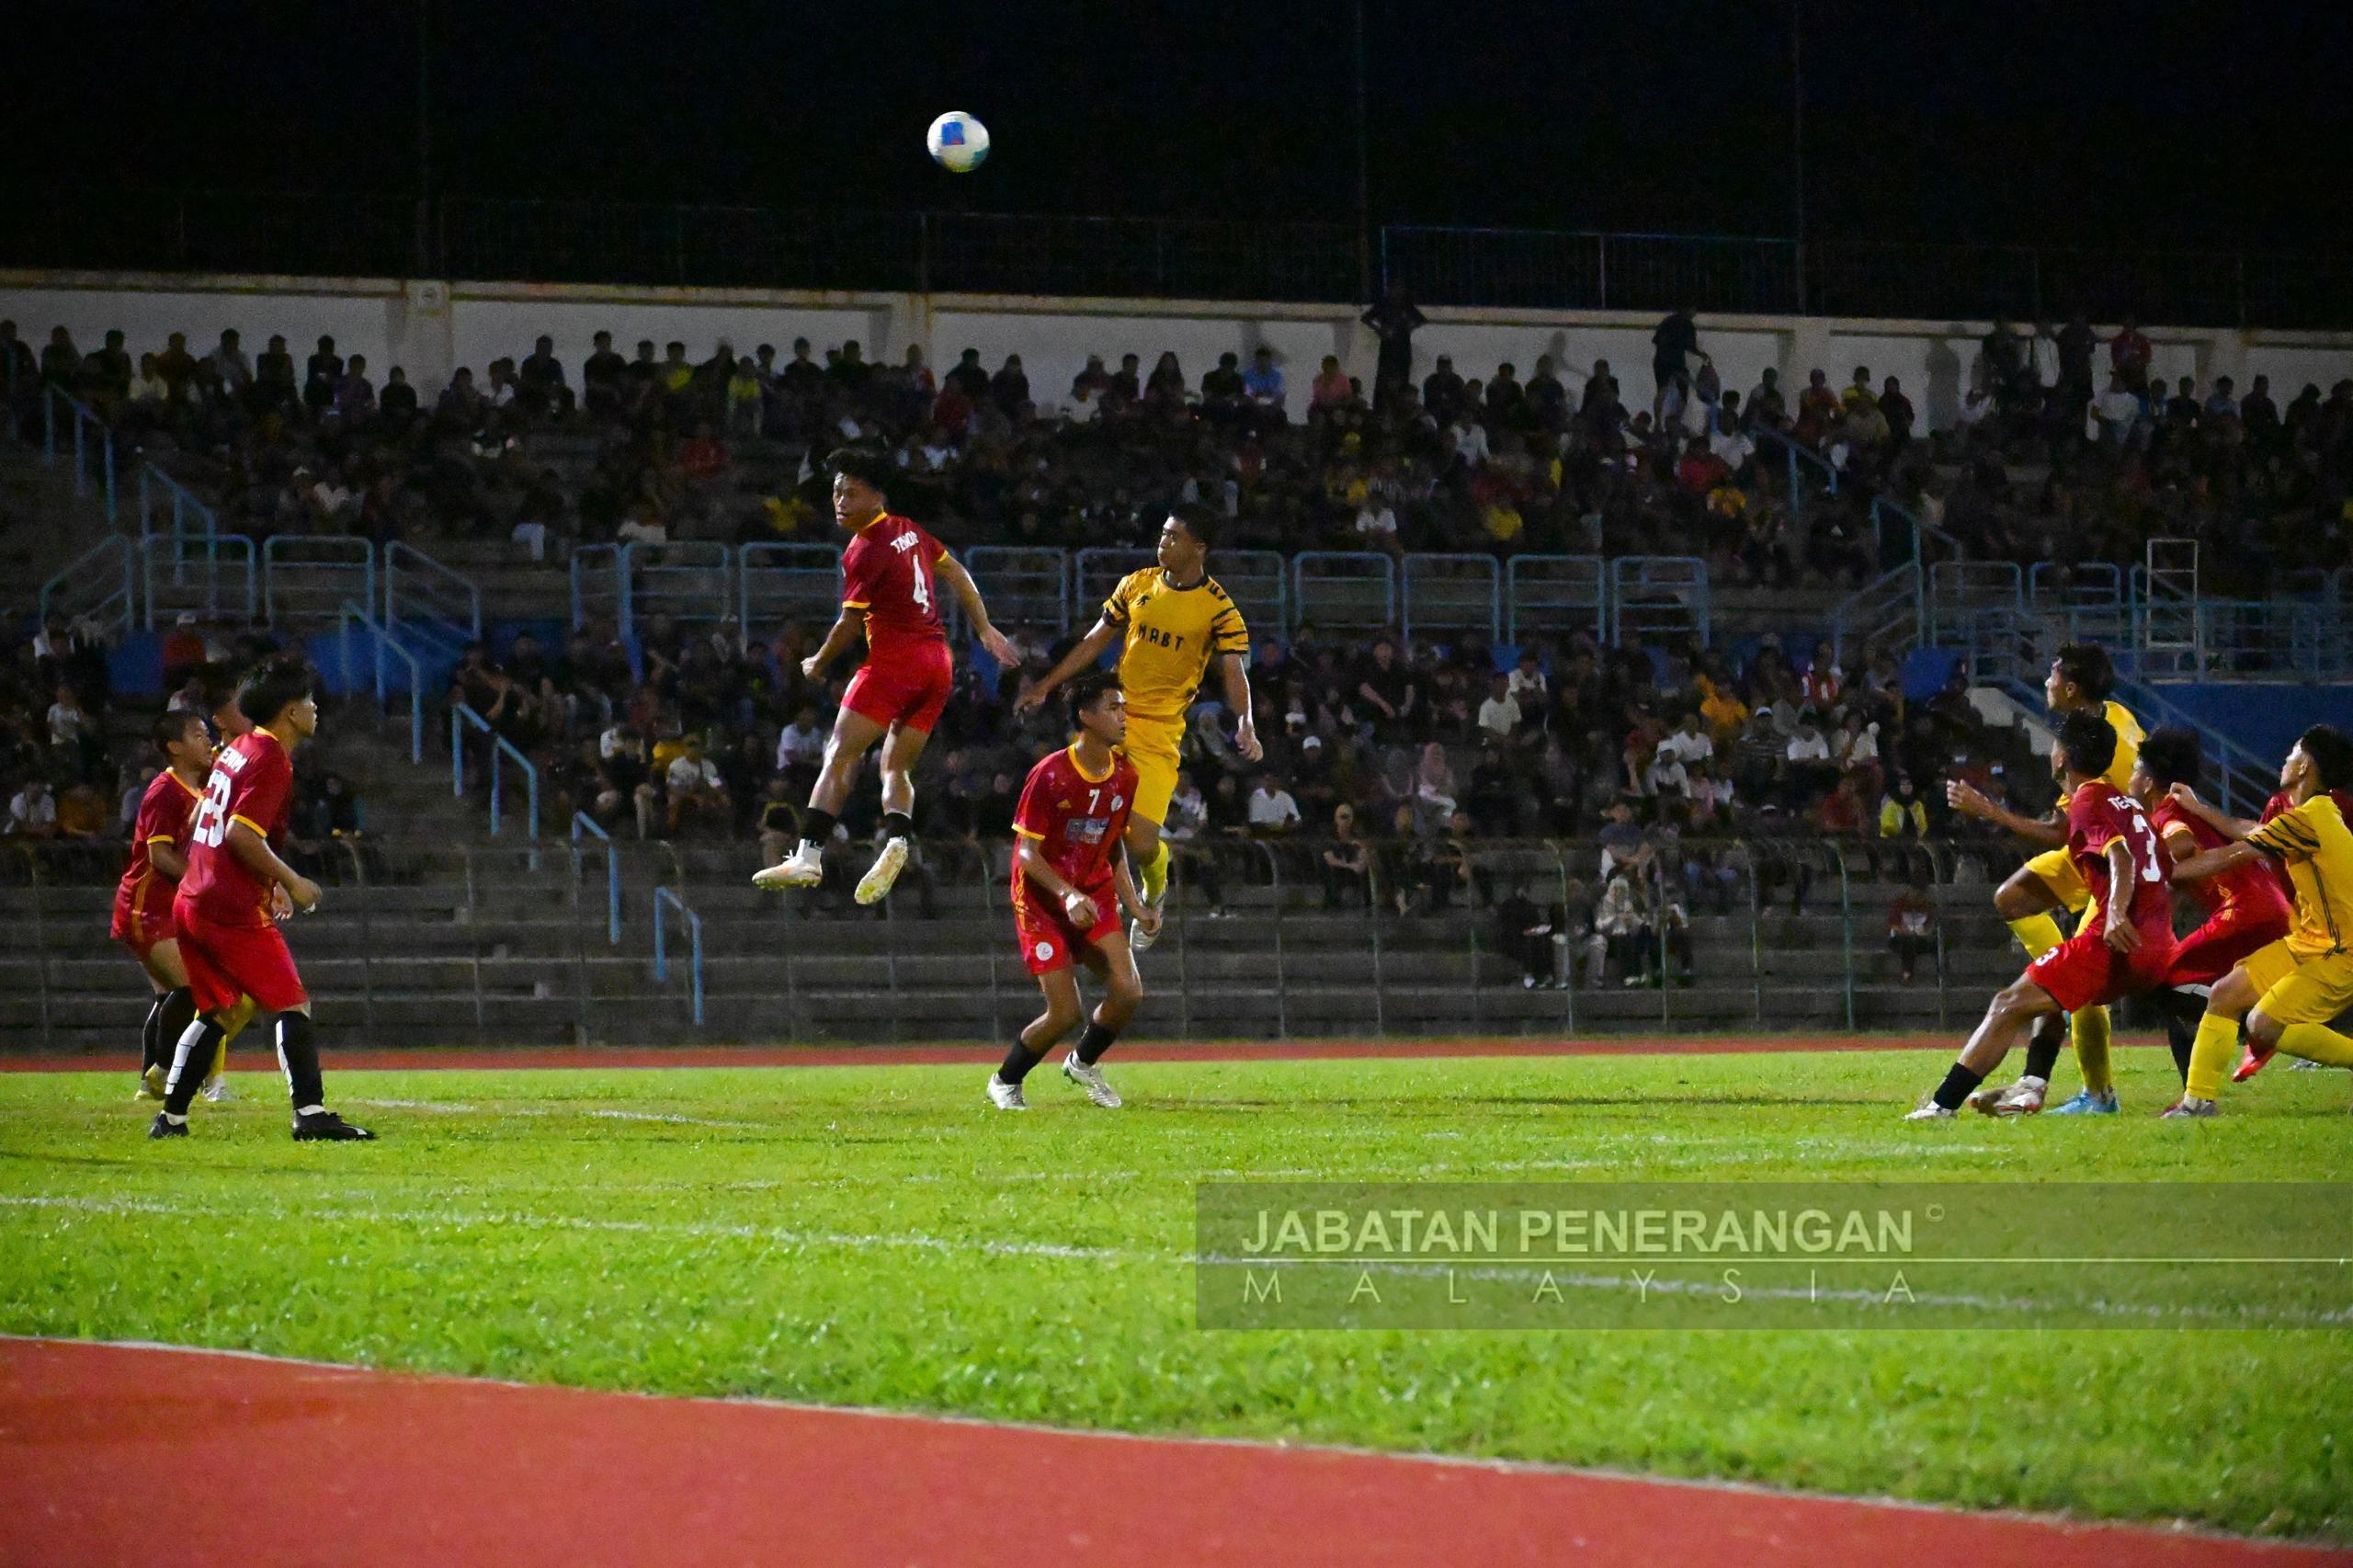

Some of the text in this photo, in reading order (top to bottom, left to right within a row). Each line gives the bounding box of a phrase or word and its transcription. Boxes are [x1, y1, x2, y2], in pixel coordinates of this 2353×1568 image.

[913, 554, 929, 614] 4
[193, 768, 232, 848] 23
[1088, 789, 1101, 815] 7
[2132, 814, 2161, 882] 3
[2035, 947, 2059, 967] 3
